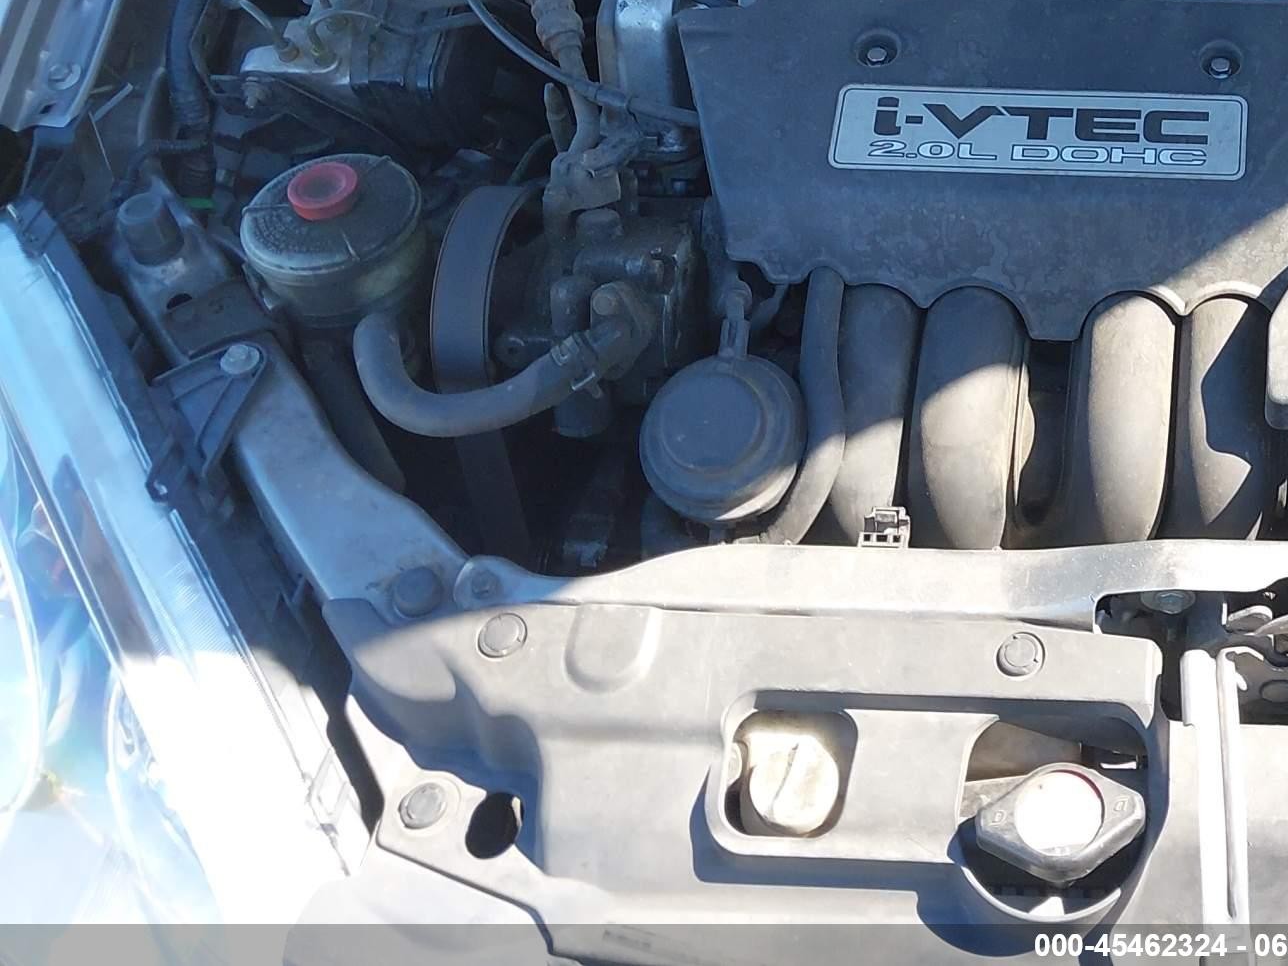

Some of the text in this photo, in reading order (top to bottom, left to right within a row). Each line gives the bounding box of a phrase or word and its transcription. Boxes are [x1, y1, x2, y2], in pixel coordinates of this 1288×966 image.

[873, 97, 1209, 145] i-VTEC
[868, 140, 1206, 166] 2.0L DOHC
